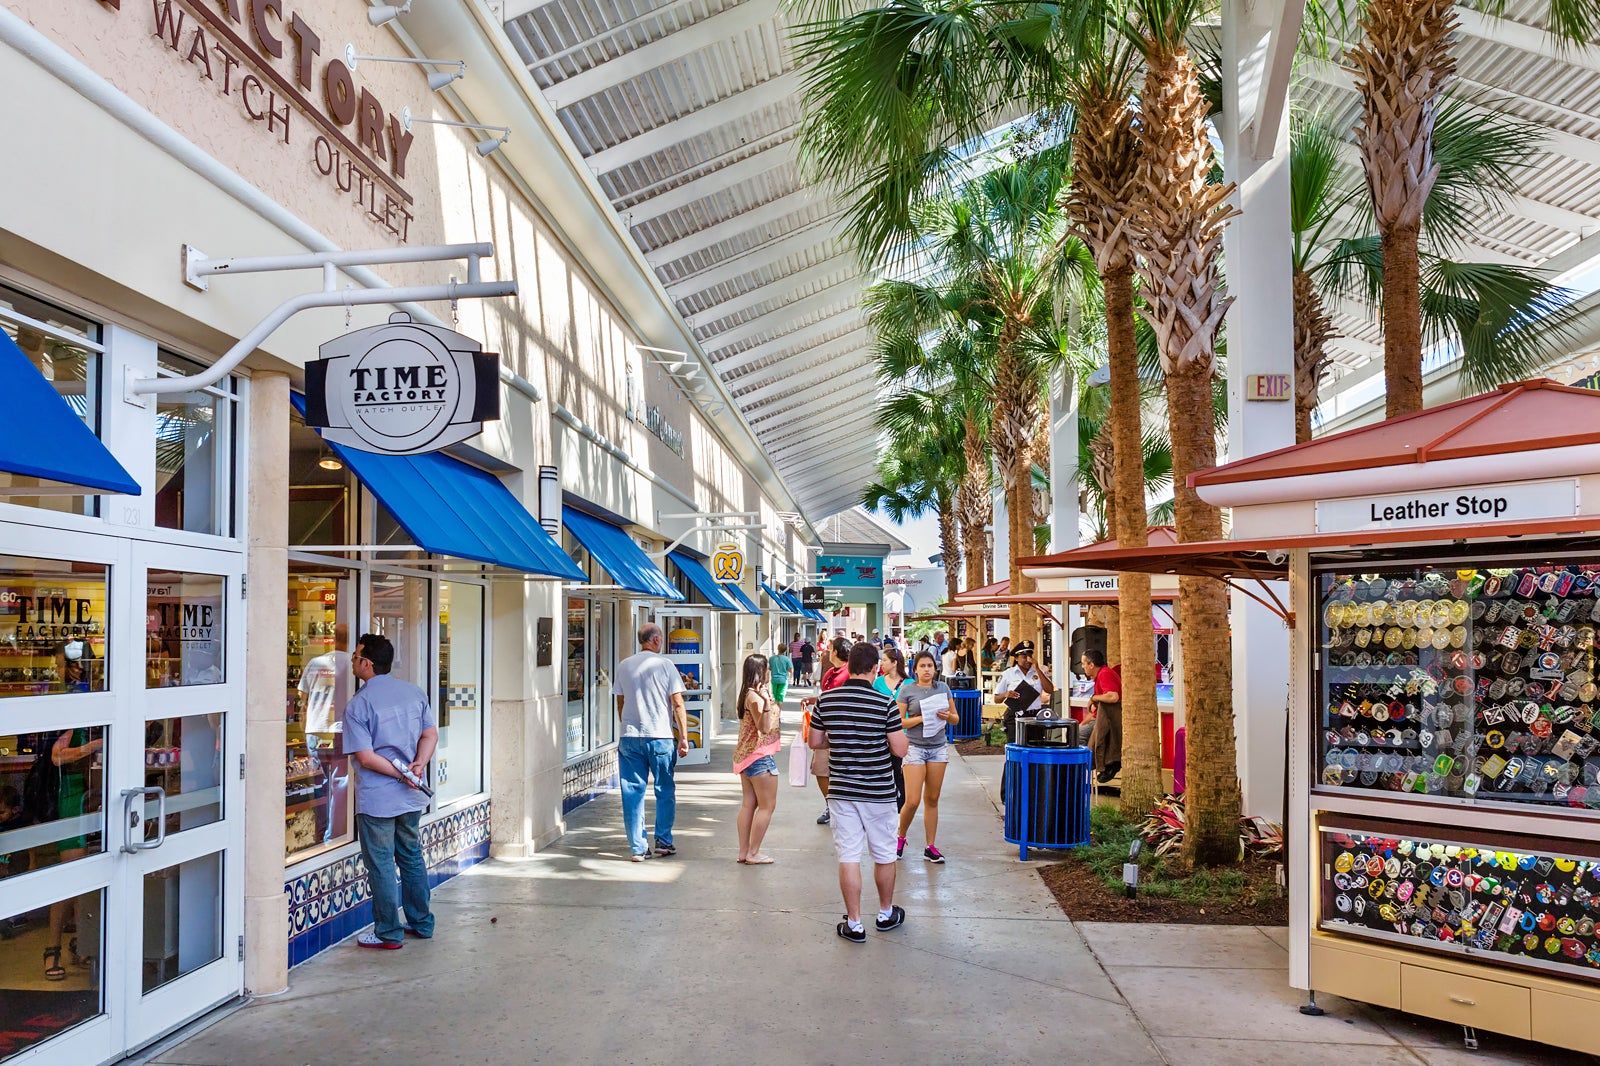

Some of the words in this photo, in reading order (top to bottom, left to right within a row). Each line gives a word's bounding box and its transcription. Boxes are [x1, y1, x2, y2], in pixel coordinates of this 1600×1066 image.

[153, 0, 290, 145] WATCH
[314, 135, 414, 243] OUTLET
[350, 365, 448, 391] TIME
[1257, 375, 1286, 397] EXIT
[354, 389, 445, 402] FACTORY
[401, 404, 447, 412] OUTLET
[1371, 499, 1450, 522] Leather
[1455, 495, 1508, 518] Stop
[1084, 578, 1114, 589] Travel
[15, 595, 93, 624] TIME
[158, 602, 214, 627] TIME
[15, 625, 91, 638] FACTORY
[158, 627, 212, 638] FACTORY
[1503, 759, 1521, 779] CAT
